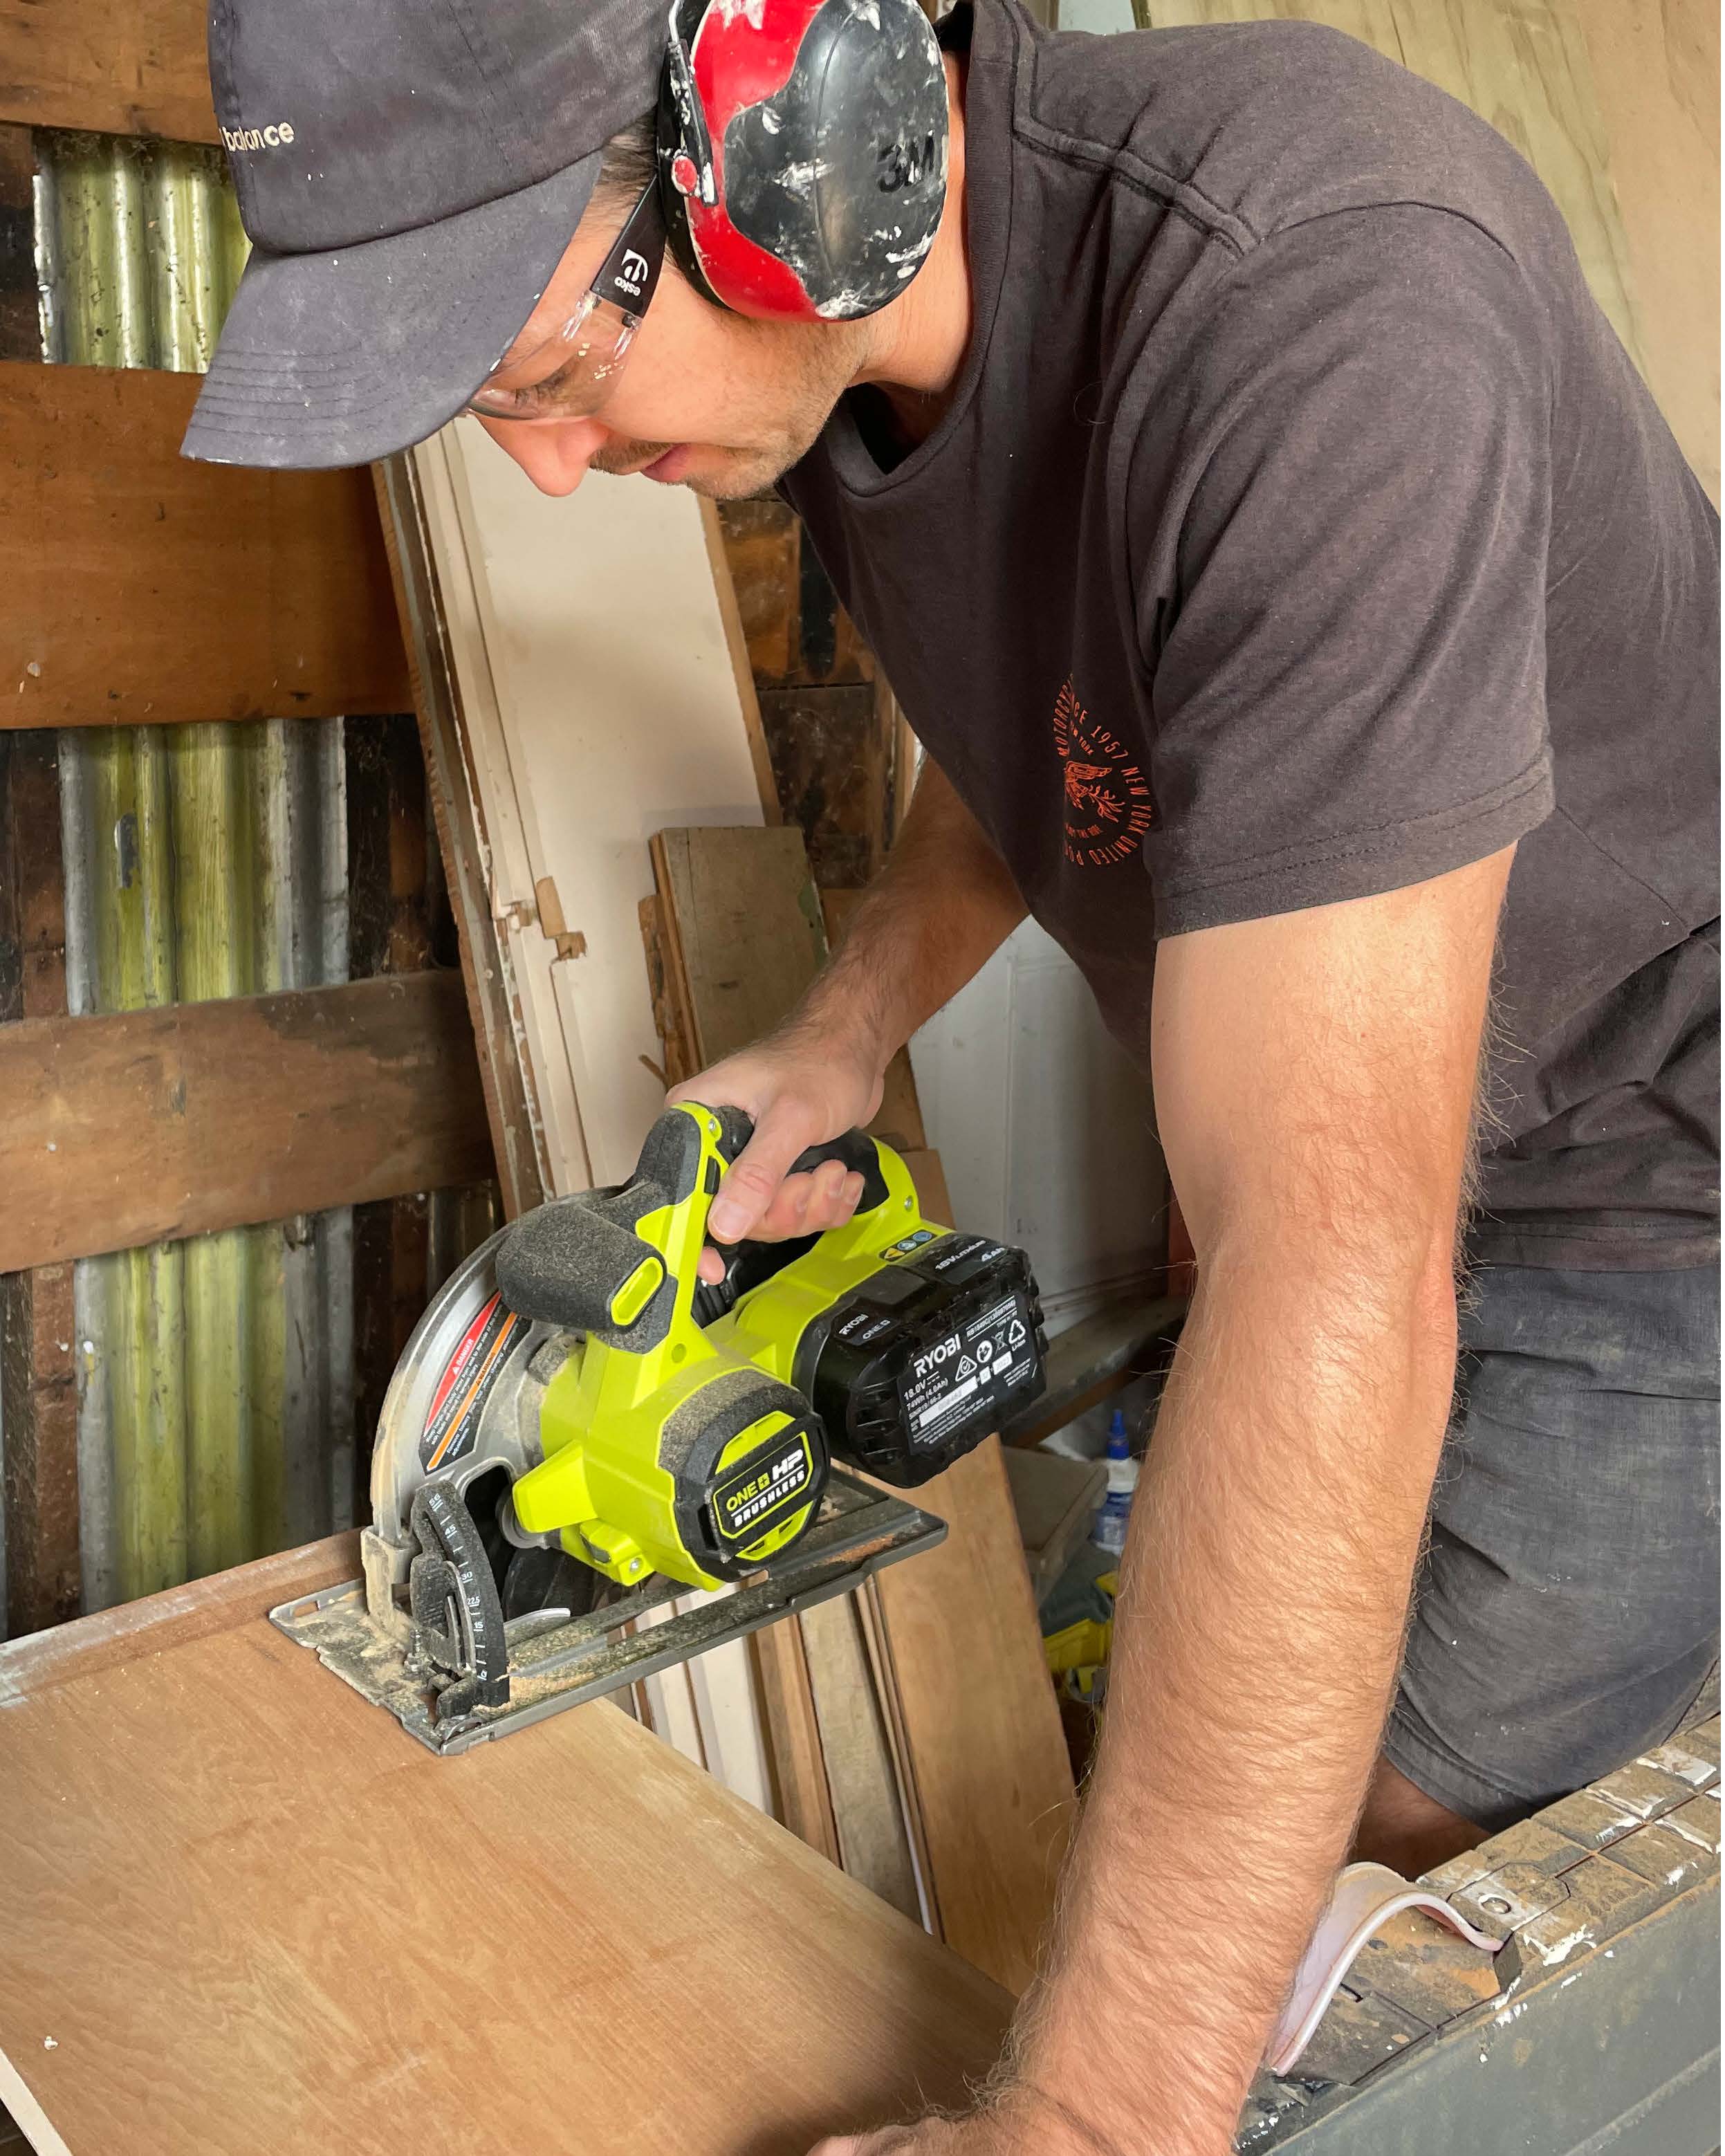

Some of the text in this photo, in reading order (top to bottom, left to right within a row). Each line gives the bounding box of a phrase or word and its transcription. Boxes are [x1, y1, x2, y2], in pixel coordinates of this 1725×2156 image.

[1121, 766, 1150, 796] NEW
[838, 1314, 869, 1335] RYOBI
[913, 1334, 961, 1378] RYOBI
[773, 1448, 804, 1480] HP
[734, 1471, 805, 1527] BRUSHLESS
[445, 1525, 456, 1536] 45
